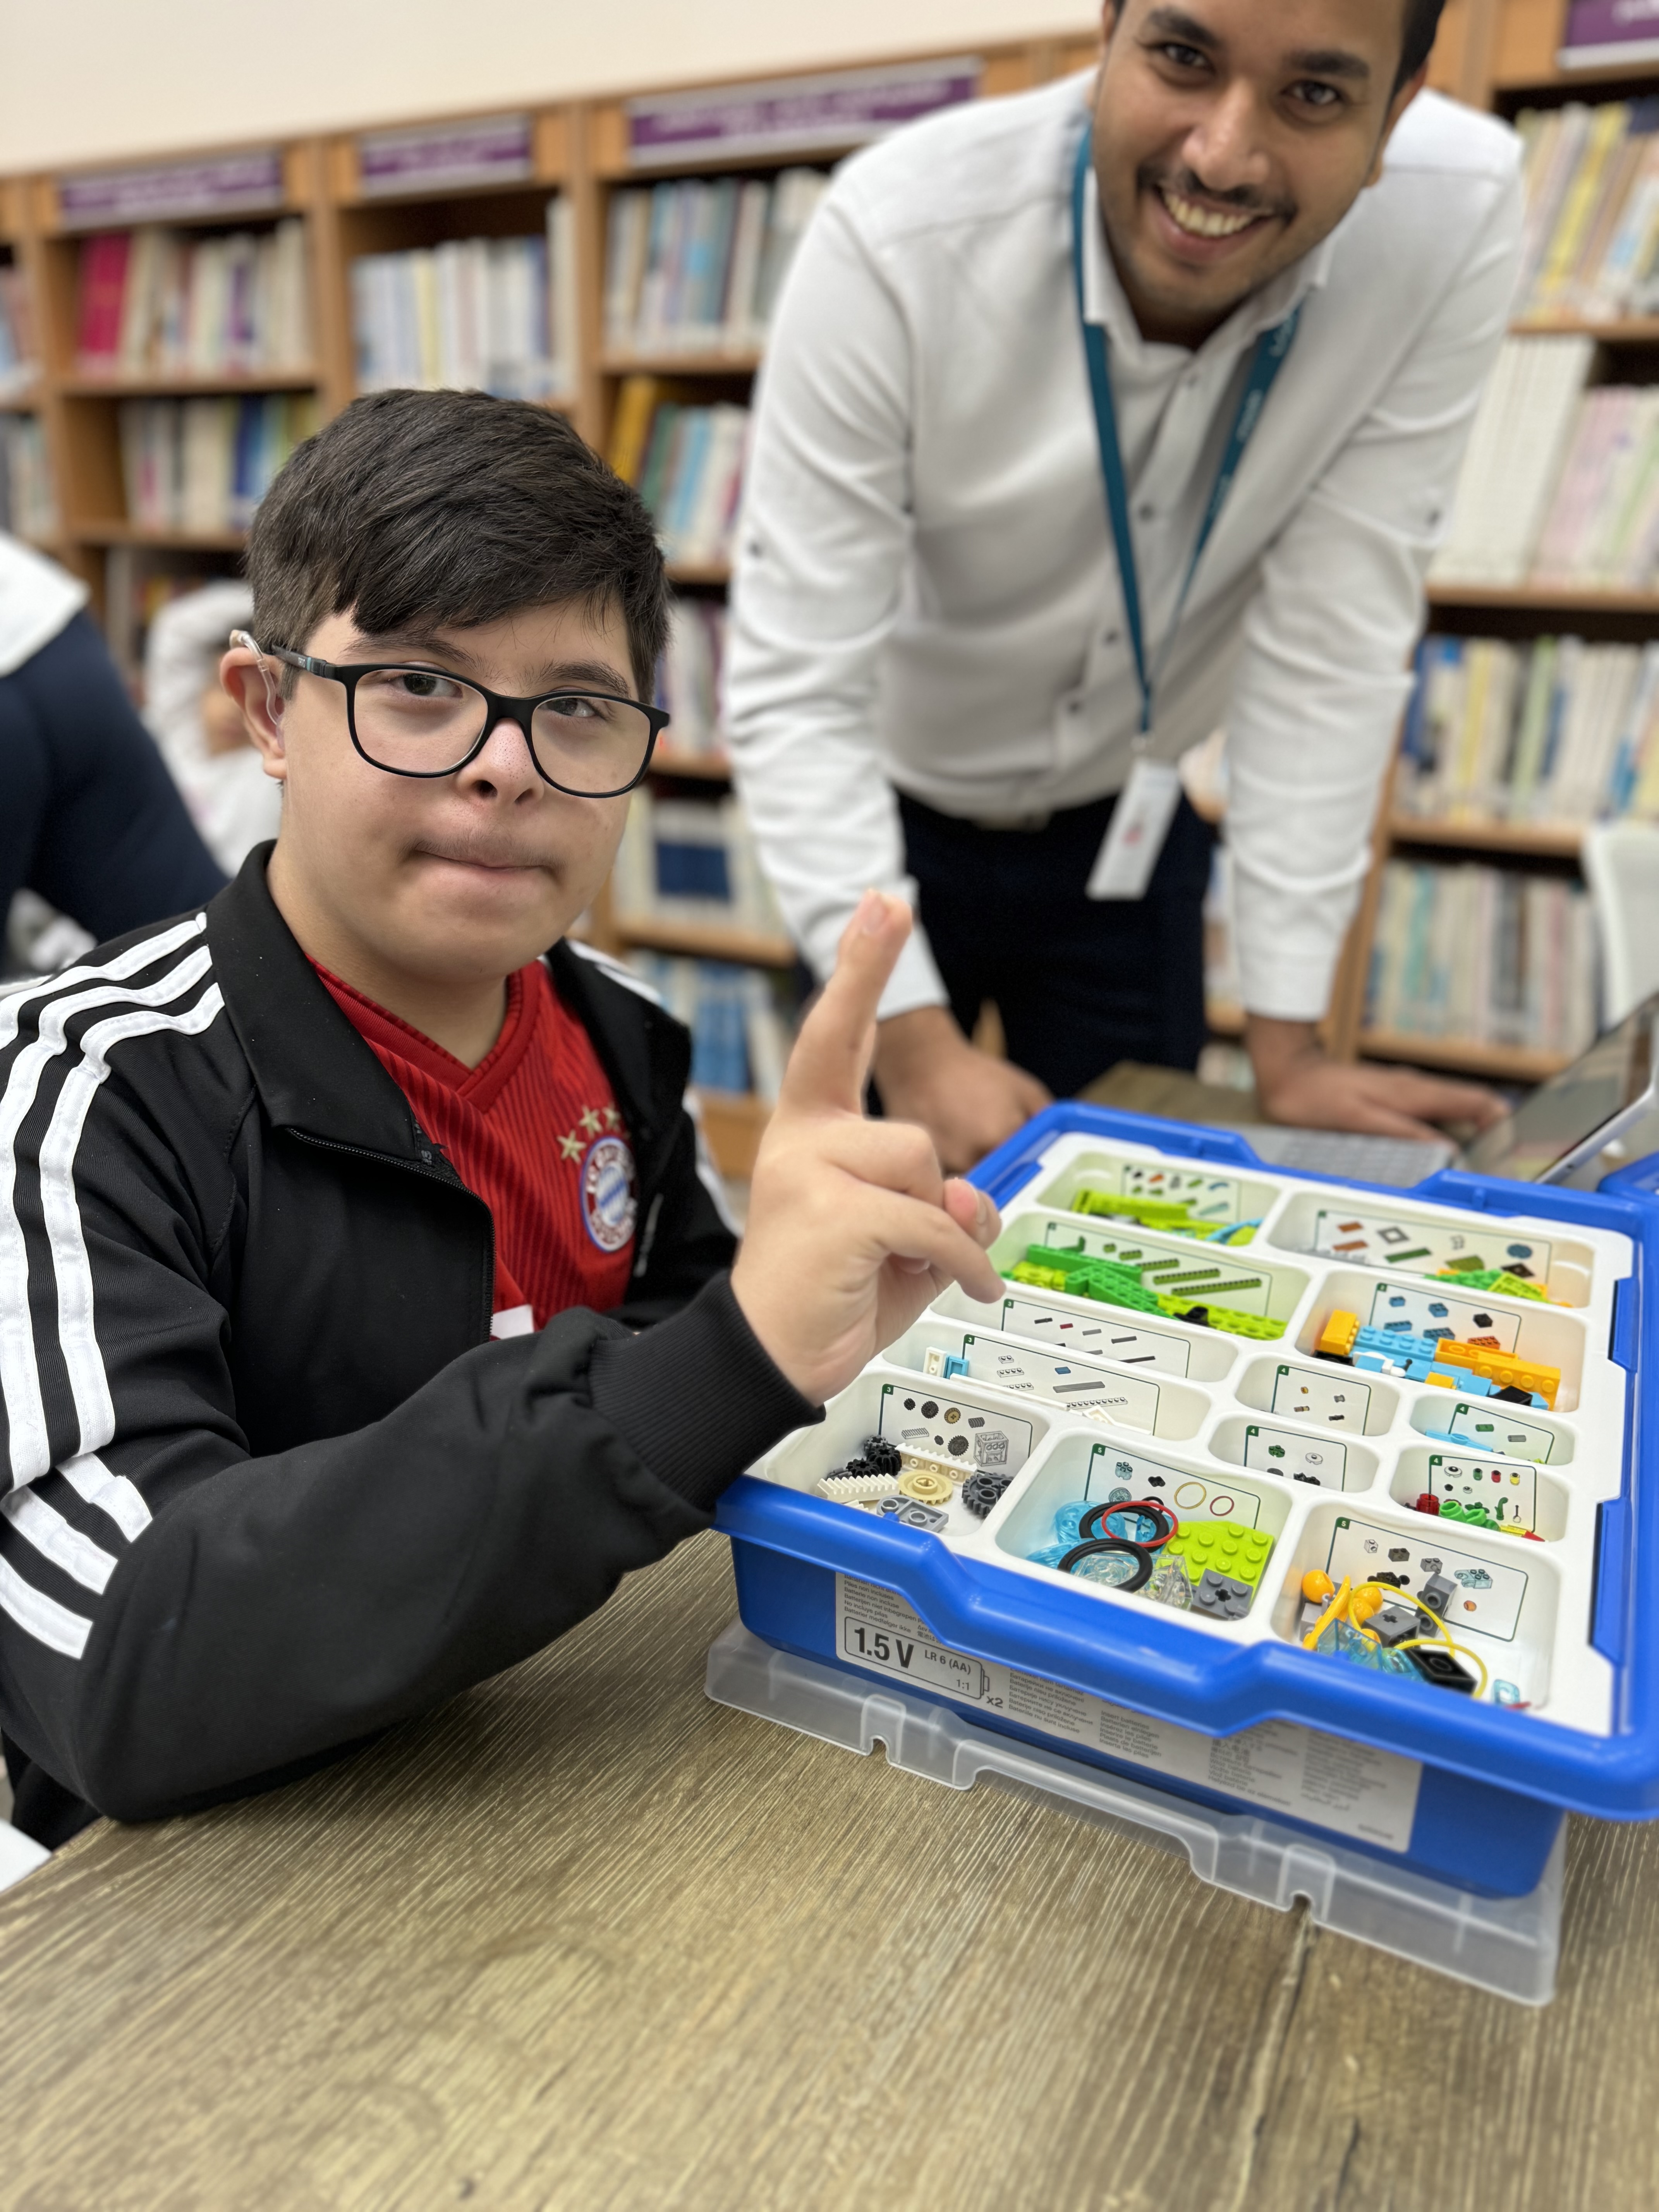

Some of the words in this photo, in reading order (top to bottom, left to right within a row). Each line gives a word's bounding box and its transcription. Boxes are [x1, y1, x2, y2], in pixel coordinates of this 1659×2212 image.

[845, 1587, 866, 1598] Batterie
[879, 1598, 899, 1609] incluse
[871, 1589, 894, 1601] incluses
[845, 1593, 870, 1606] Batterijen
[884, 1607, 916, 1621] inbegrepen
[845, 1606, 867, 1618] Batterier
[854, 1602, 873, 1614] incluye
[874, 1609, 888, 1618] pilas
[854, 1627, 890, 1661] 1.5
[895, 1639, 914, 1669] V
[925, 1649, 937, 1661] LR
[939, 1656, 946, 1664] 6
[949, 1658, 971, 1675] (AA)
[956, 1679, 970, 1690] 1:1
[986, 1695, 1003, 1709] x2
